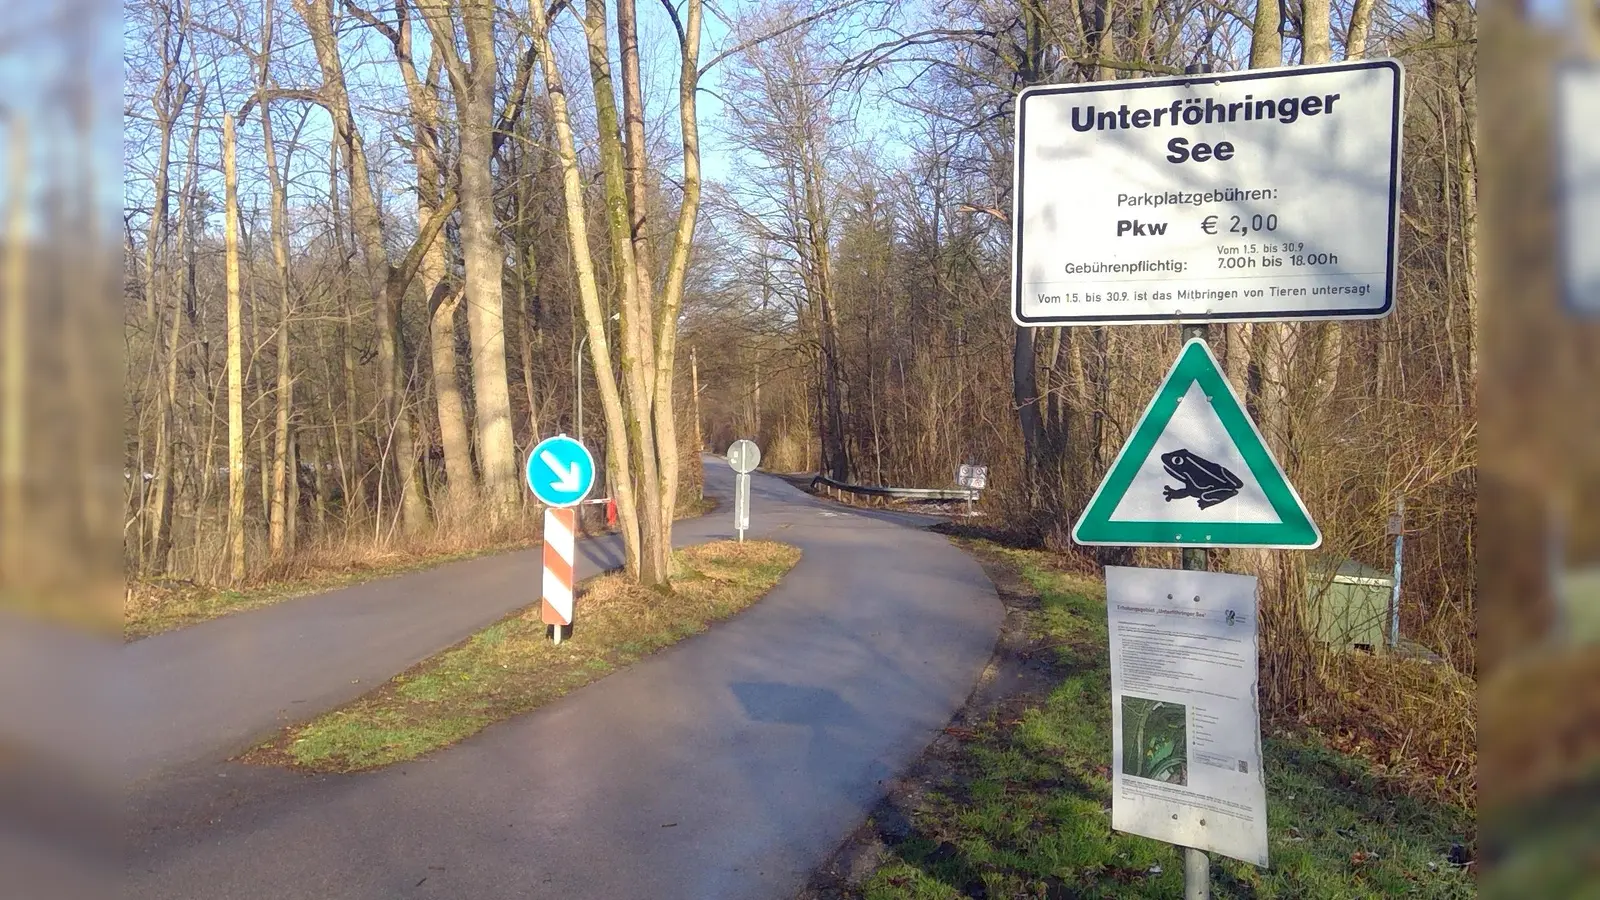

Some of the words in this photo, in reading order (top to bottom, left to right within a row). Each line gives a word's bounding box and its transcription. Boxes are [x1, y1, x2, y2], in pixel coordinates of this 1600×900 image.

[1071, 93, 1341, 132] Unterföhringer
[1166, 137, 1235, 163] See
[1117, 187, 1278, 209] Parkplatzgebühren:
[1117, 219, 1168, 237] Pkw
[1200, 215, 1219, 235] €
[1230, 213, 1278, 237] 2,00
[1217, 245, 1239, 255] Vom
[1243, 244, 1259, 254] 1.5.
[1263, 243, 1278, 253] bis
[1282, 242, 1304, 252] 30.9
[1065, 260, 1187, 274] Gebührenpflichtig:
[1218, 256, 1256, 269] 7.00h
[1262, 255, 1283, 267] bis
[1290, 253, 1338, 266] 18.00h
[1038, 293, 1061, 304] Vom
[1066, 293, 1081, 303] 1.5.
[1085, 292, 1101, 302] bis
[1106, 291, 1130, 302] 30.9.
[1134, 291, 1148, 301] ist
[1152, 290, 1172, 300] das
[1177, 289, 1238, 301] Mitbringen
[1243, 288, 1264, 298] von
[1269, 286, 1307, 297] Tieren
[1312, 284, 1371, 297] untersagt
